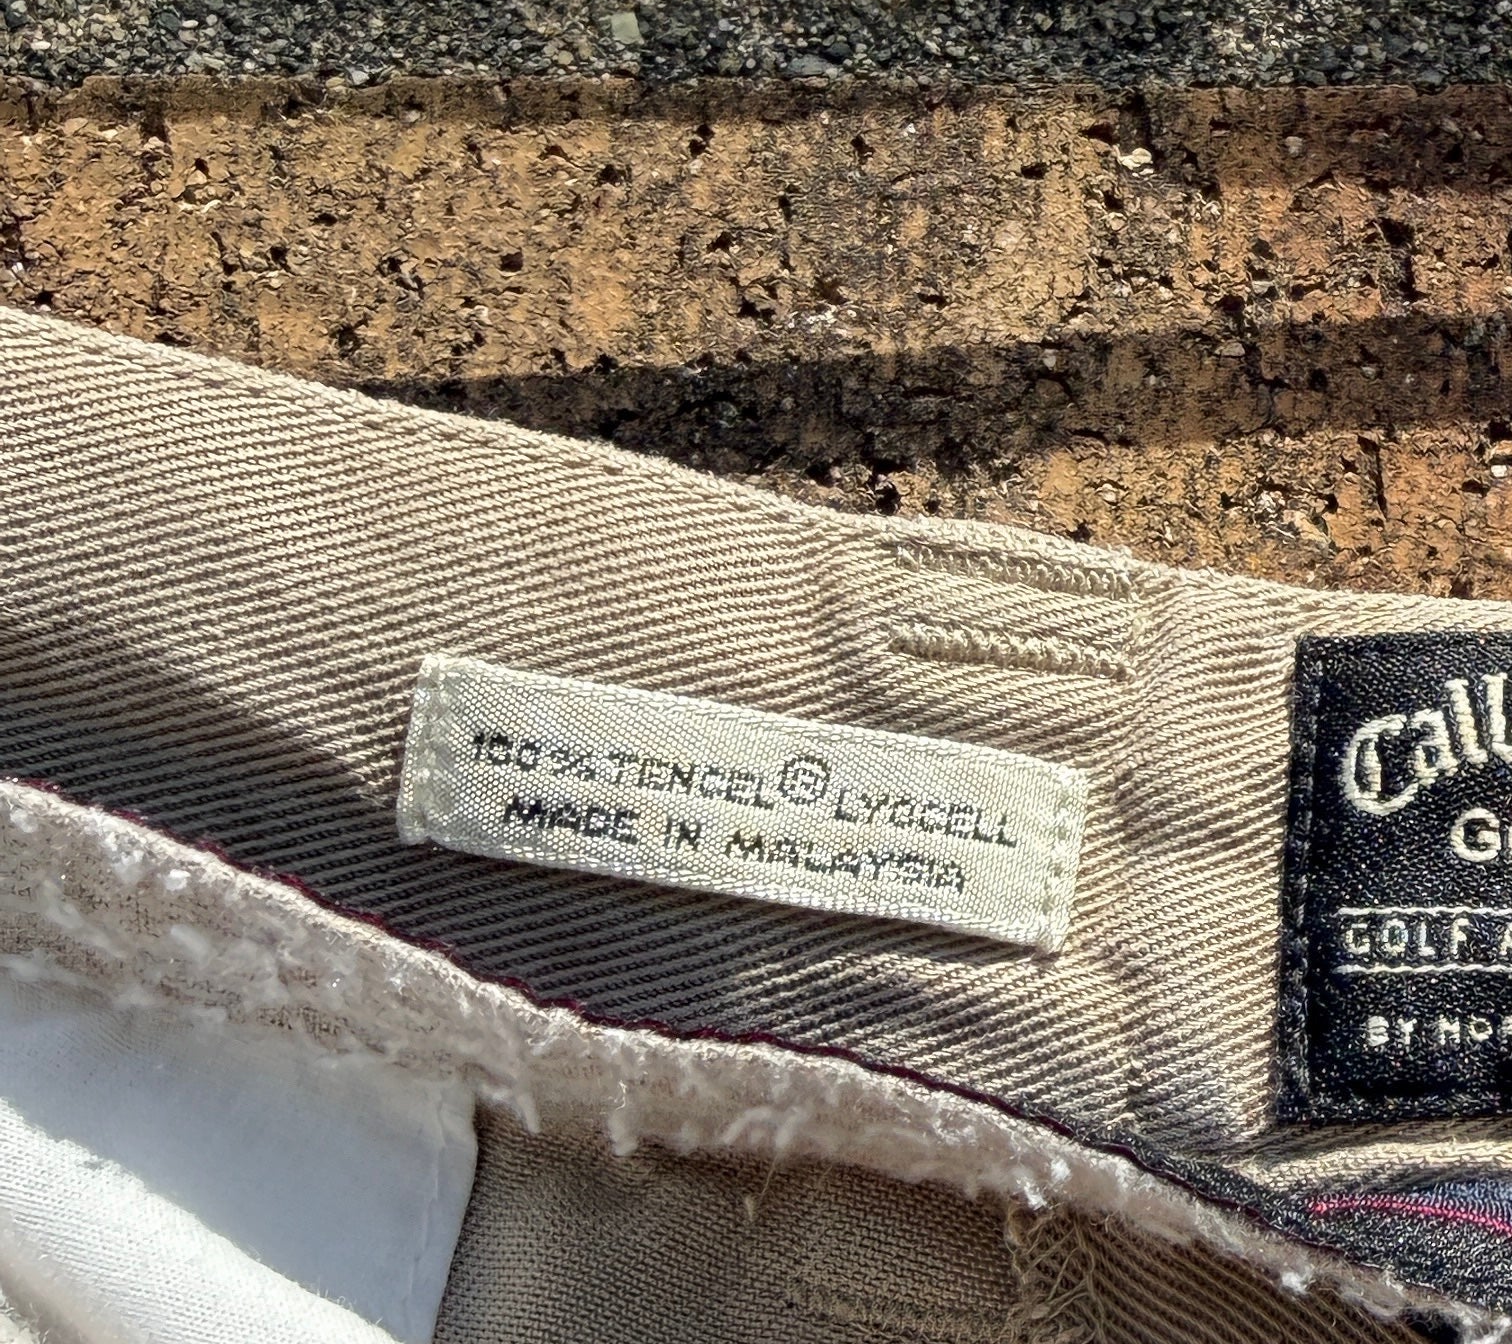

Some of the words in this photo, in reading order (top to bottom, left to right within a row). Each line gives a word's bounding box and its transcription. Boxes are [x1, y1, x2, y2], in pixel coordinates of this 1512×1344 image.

[503, 794, 639, 846] MADE
[664, 815, 701, 852] IN
[725, 828, 965, 894] MALAYSIA
[1344, 916, 1472, 957] GOLF
[1365, 1012, 1417, 1047] BY
